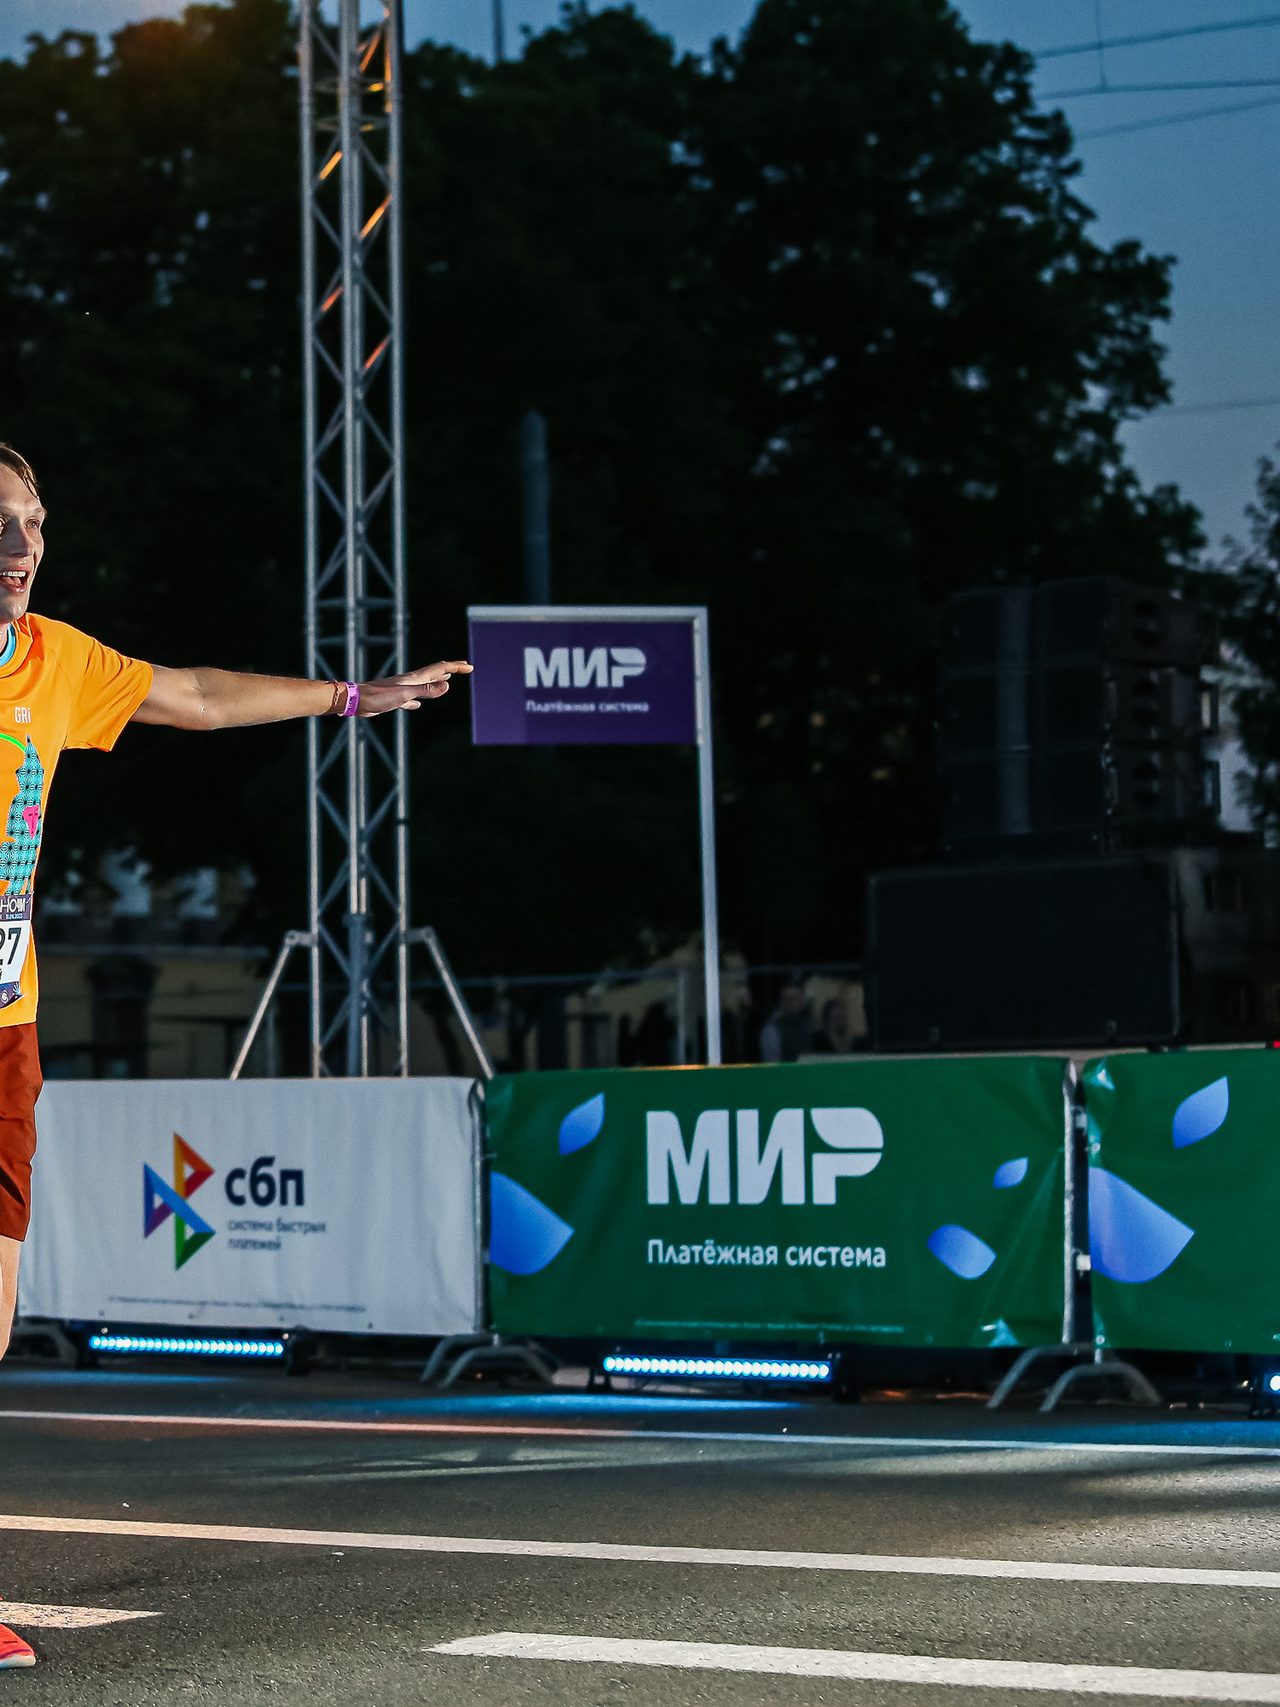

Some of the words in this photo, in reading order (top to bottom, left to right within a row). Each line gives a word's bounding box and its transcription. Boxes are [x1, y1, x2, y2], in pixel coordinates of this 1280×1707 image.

[524, 646, 647, 688] МИР
[15, 707, 31, 723] GRi
[0, 899, 26, 913] НОЧИ
[645, 1106, 885, 1206] МИР
[224, 1155, 305, 1207] сбп
[228, 1219, 273, 1232] система
[276, 1217, 327, 1234] быстрых
[647, 1239, 778, 1266] Платёжная
[785, 1246, 888, 1268] система
